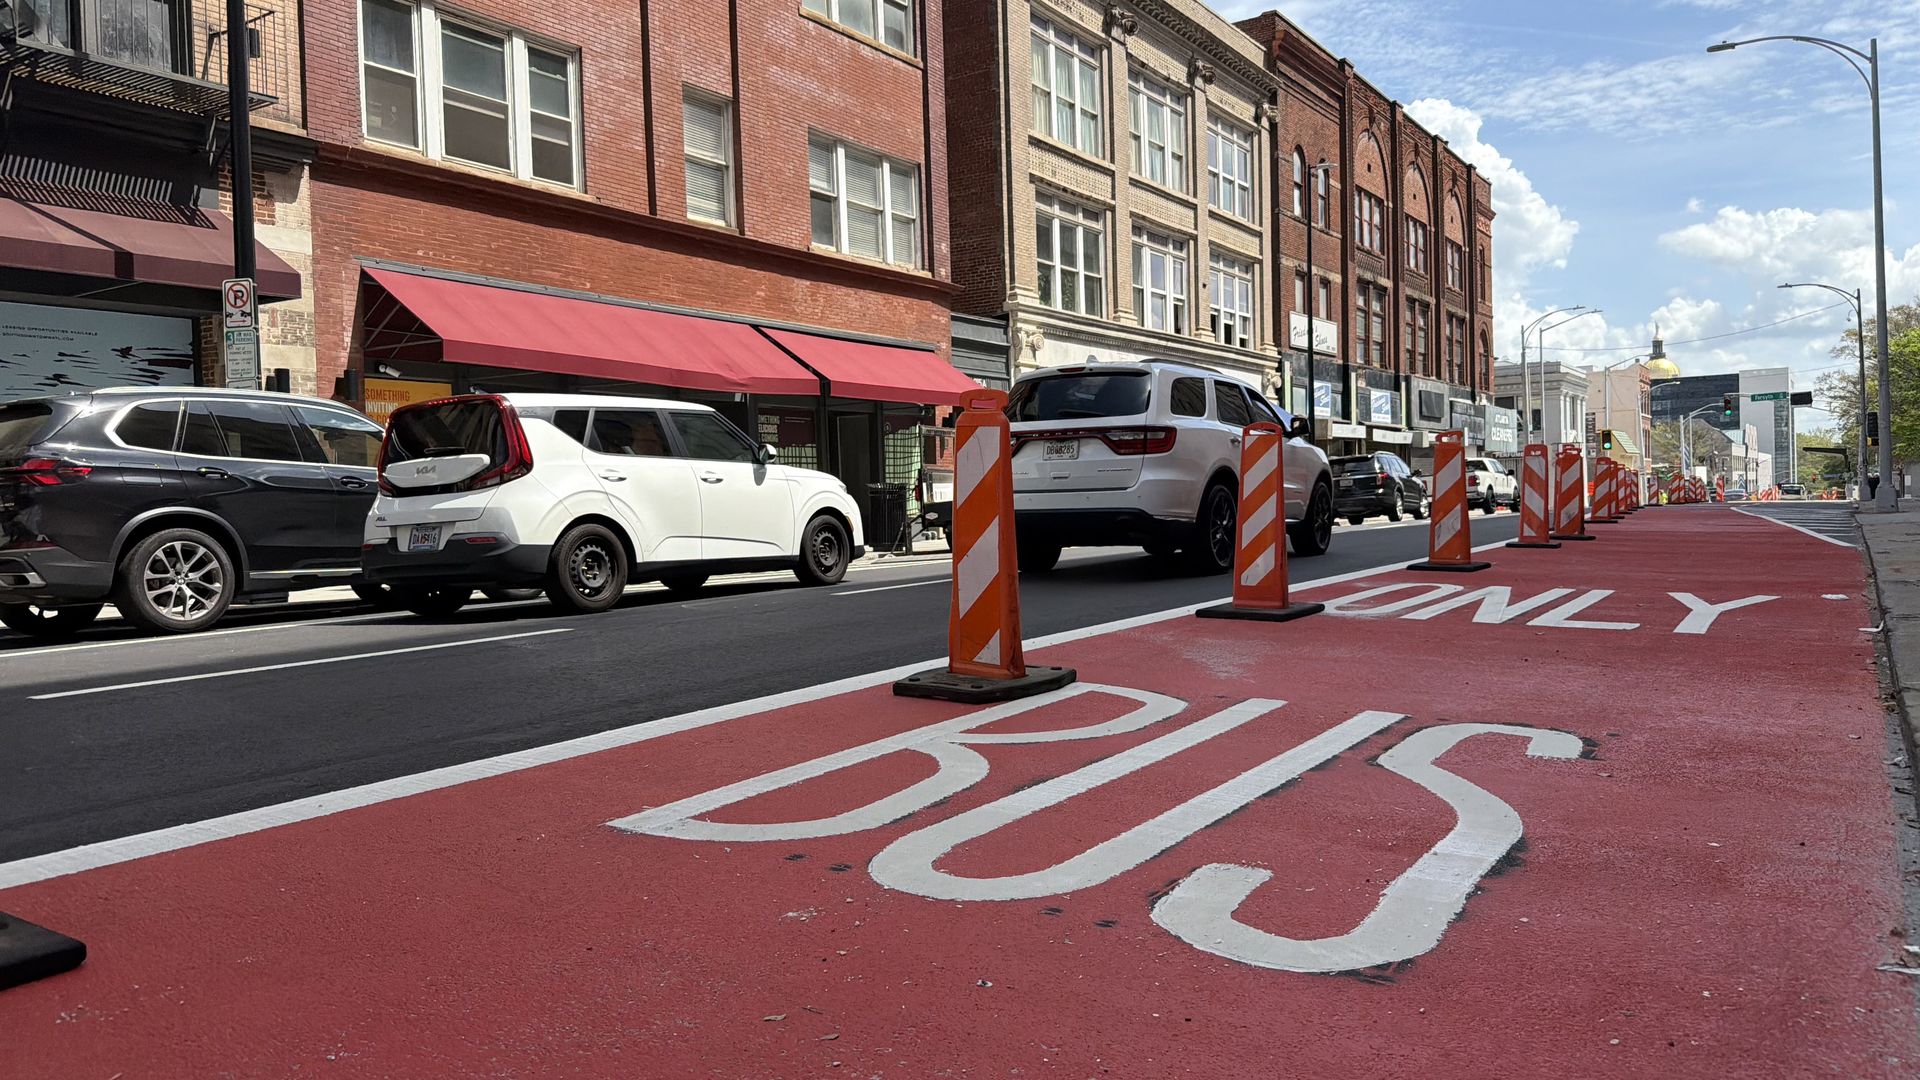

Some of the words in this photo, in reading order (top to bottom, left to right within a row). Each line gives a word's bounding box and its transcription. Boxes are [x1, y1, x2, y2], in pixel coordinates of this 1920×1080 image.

[365, 388, 410, 402] SOMETHING
[758, 414, 780, 425] OMETHING
[758, 423, 778, 433] ELICIOUS
[1318, 583, 1781, 634] ONLY
[607, 682, 1583, 973] BUS
